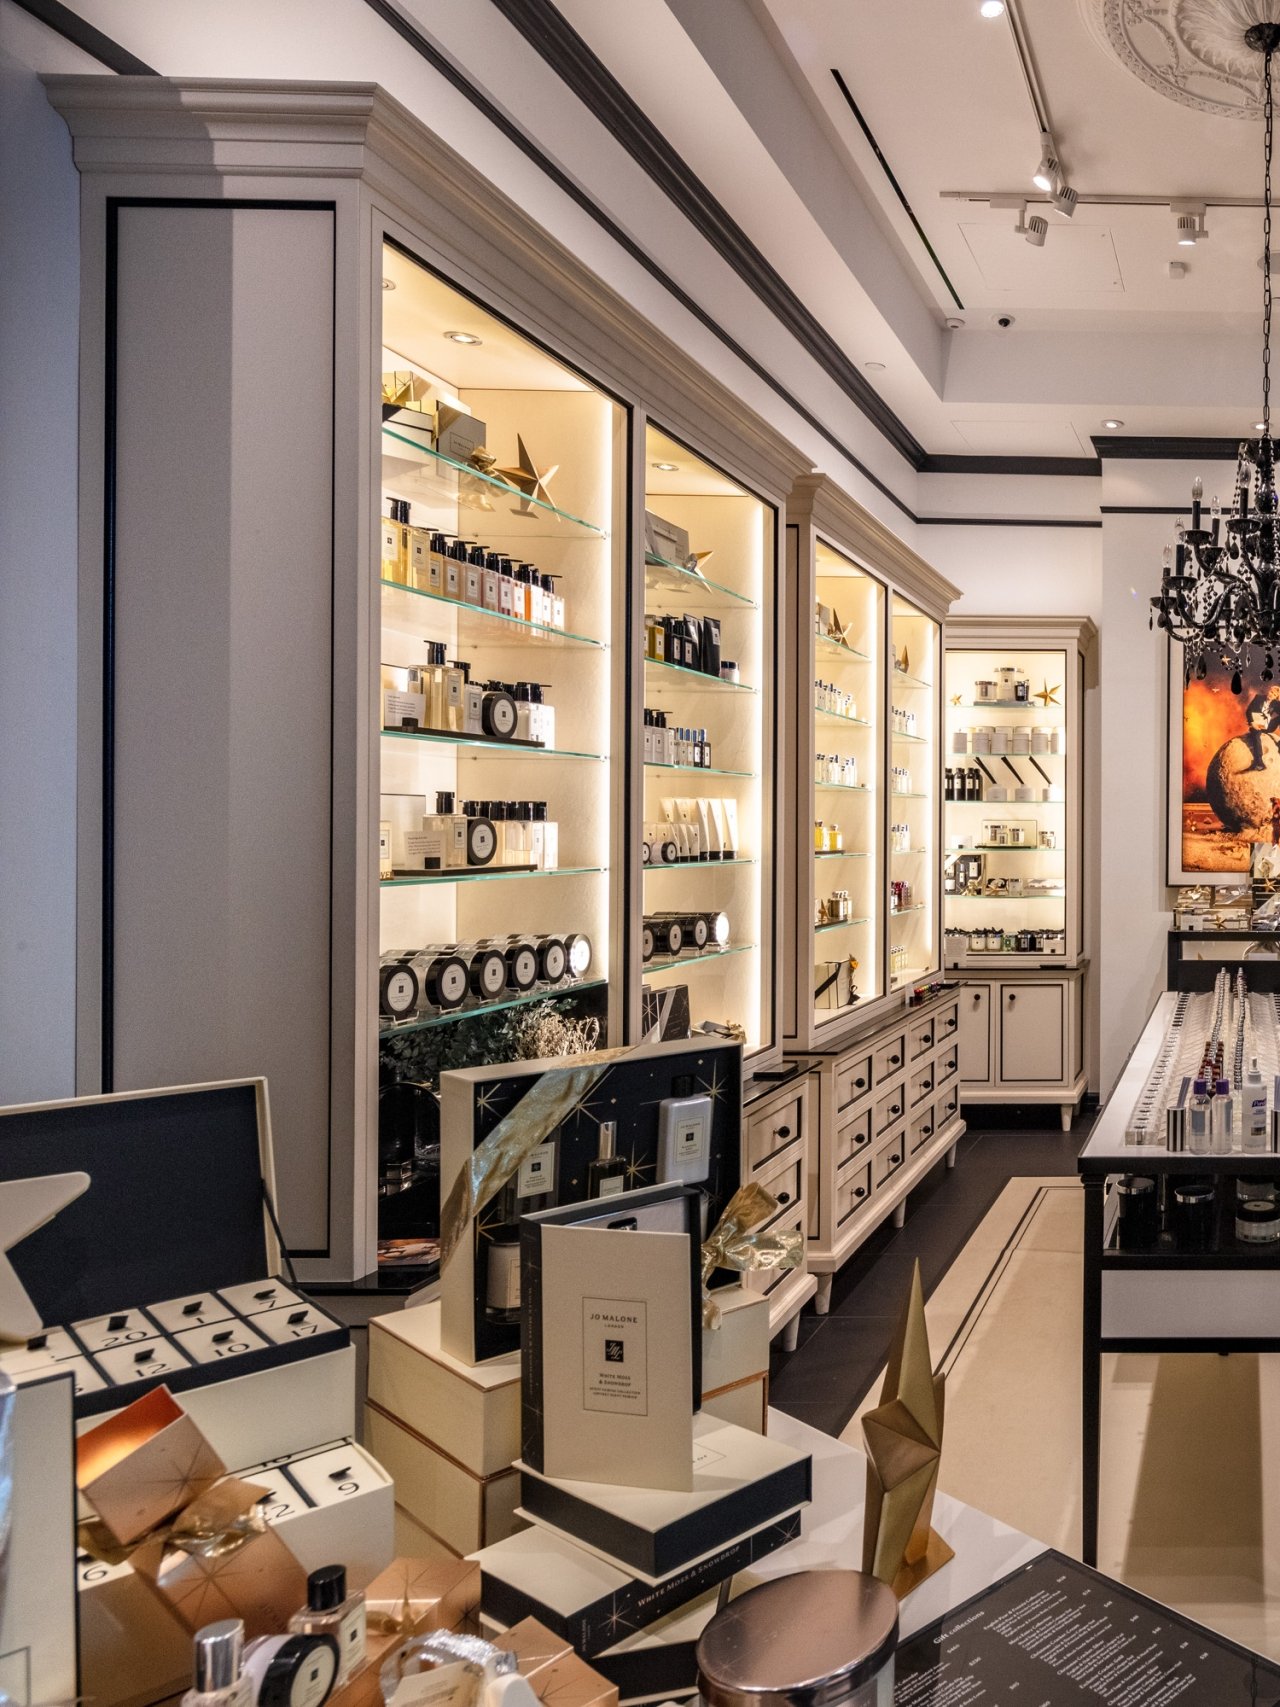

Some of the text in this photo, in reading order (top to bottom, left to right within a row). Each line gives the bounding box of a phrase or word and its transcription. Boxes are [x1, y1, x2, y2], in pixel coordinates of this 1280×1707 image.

[260, 1300, 276, 1308] 7
[602, 1314, 638, 1323] MALONE
[291, 1324, 318, 1337] 17
[101, 1331, 147, 1348] 20
[214, 1343, 249, 1357] 10
[135, 1363, 171, 1377] 12
[338, 1482, 359, 1495] 9
[83, 1565, 107, 1581] 6
[637, 1589, 665, 1607] WHITE
[667, 1575, 689, 1592] MOSS
[698, 1545, 740, 1574] SNOWDROP
[933, 1611, 985, 1644] Gift collections
